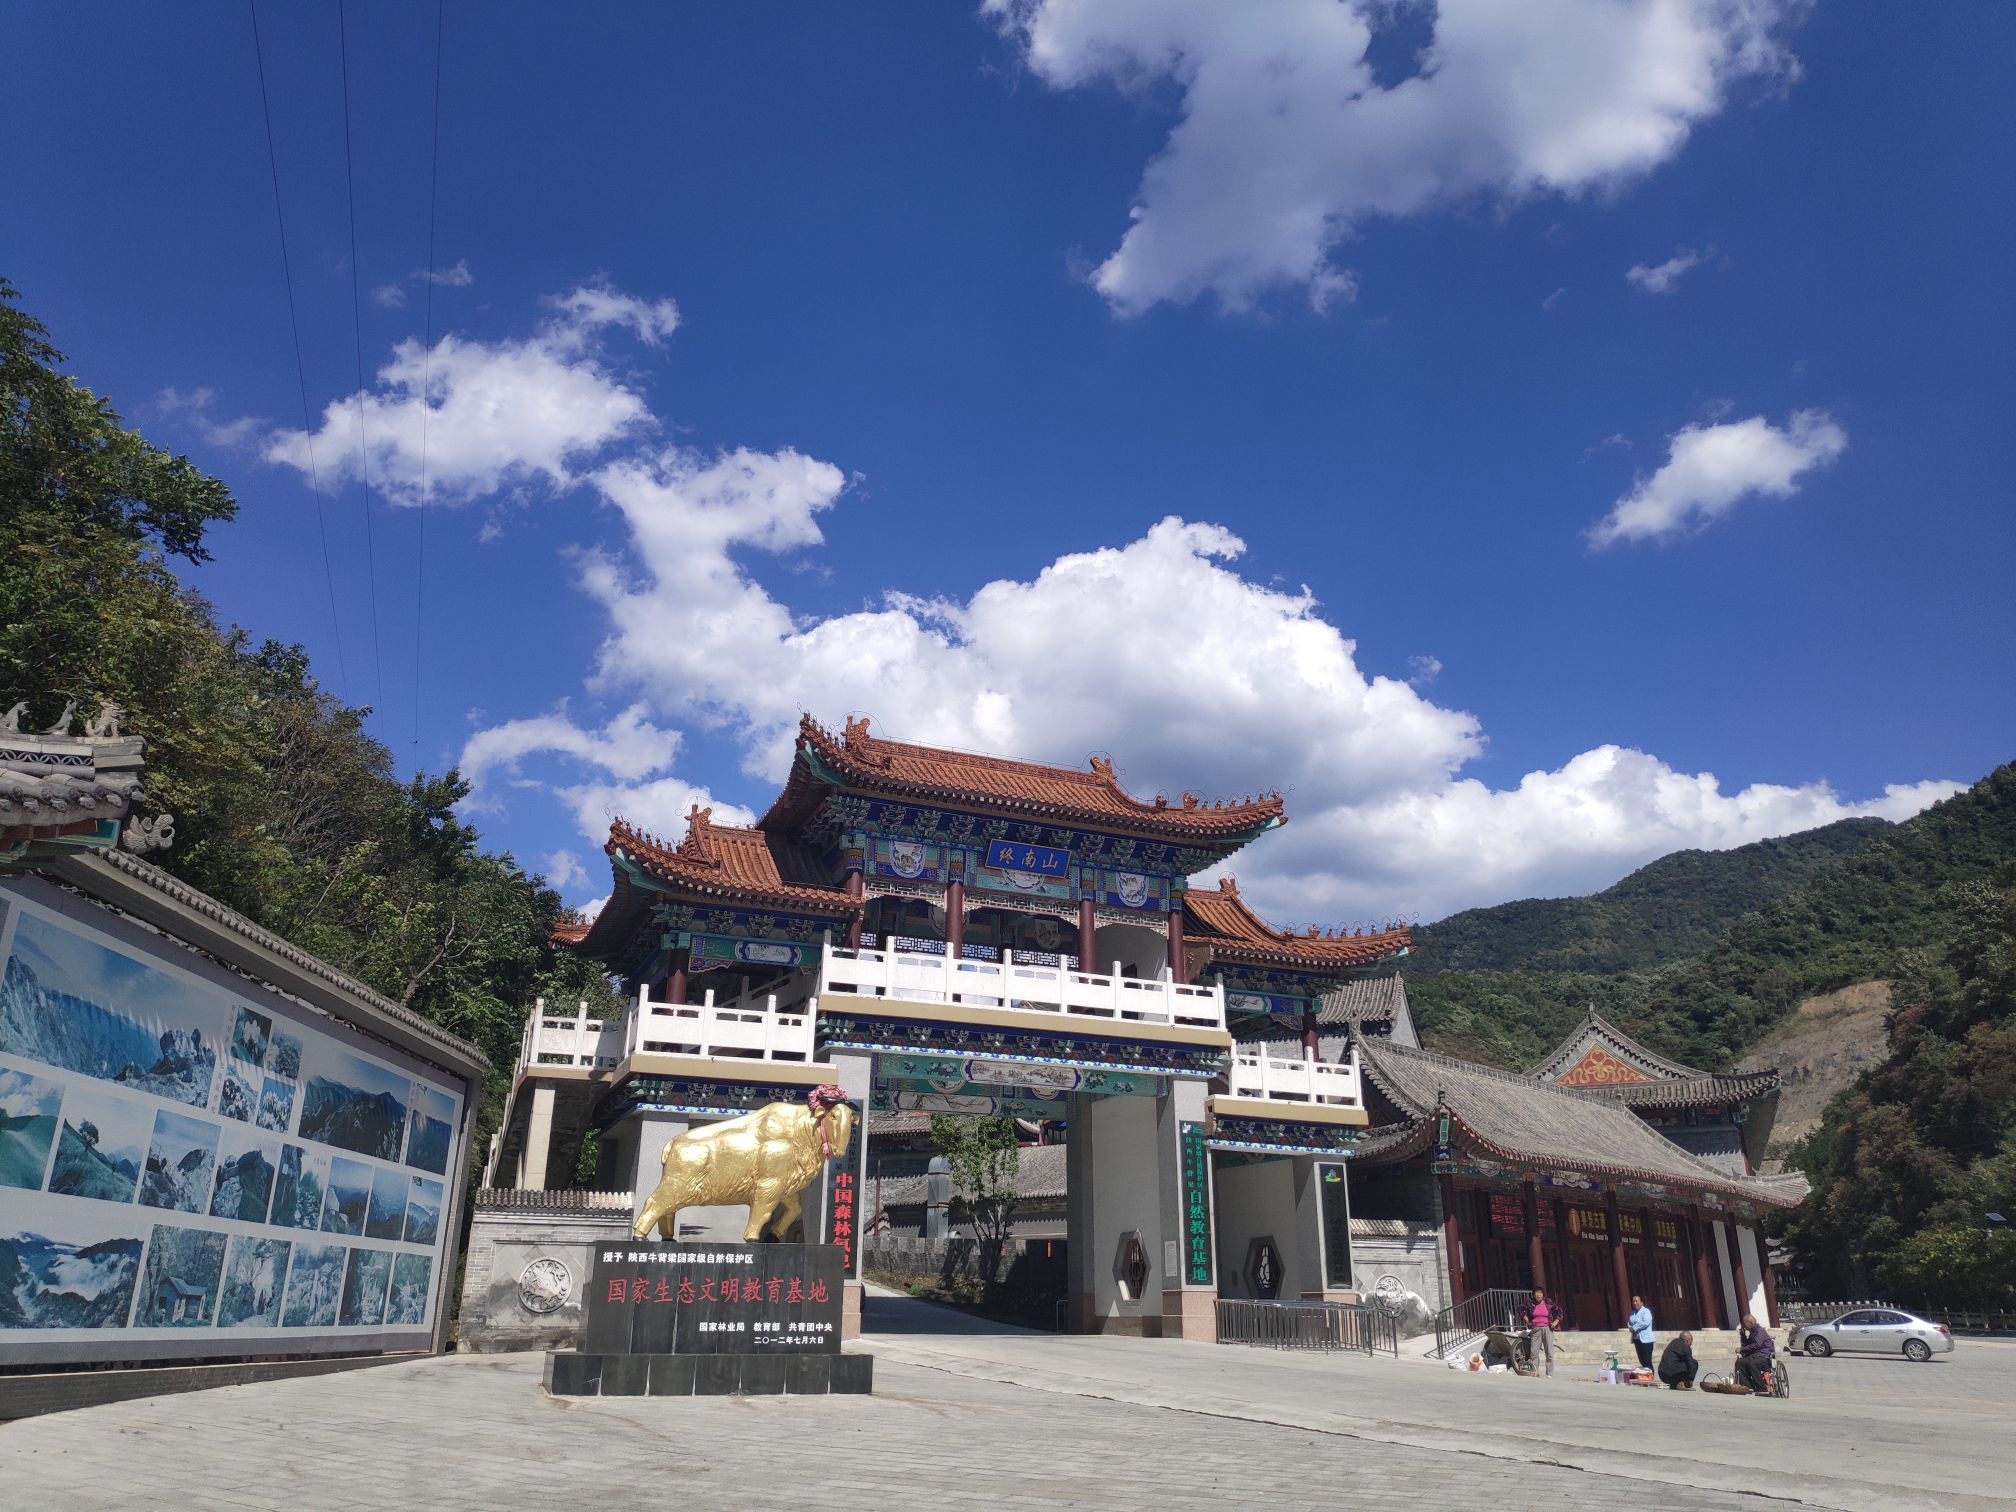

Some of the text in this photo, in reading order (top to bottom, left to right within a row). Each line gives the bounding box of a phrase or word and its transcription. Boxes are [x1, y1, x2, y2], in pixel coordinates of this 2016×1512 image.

[1189, 1190, 1207, 1281] 自然教育基地
[603, 1252, 754, 1264] 授予 陕西牛背梁国家级自然保护区
[607, 1277, 829, 1304] 国家生态文明教育基地
[699, 1322, 833, 1332] 国家林业局 教育部 共青团中央
